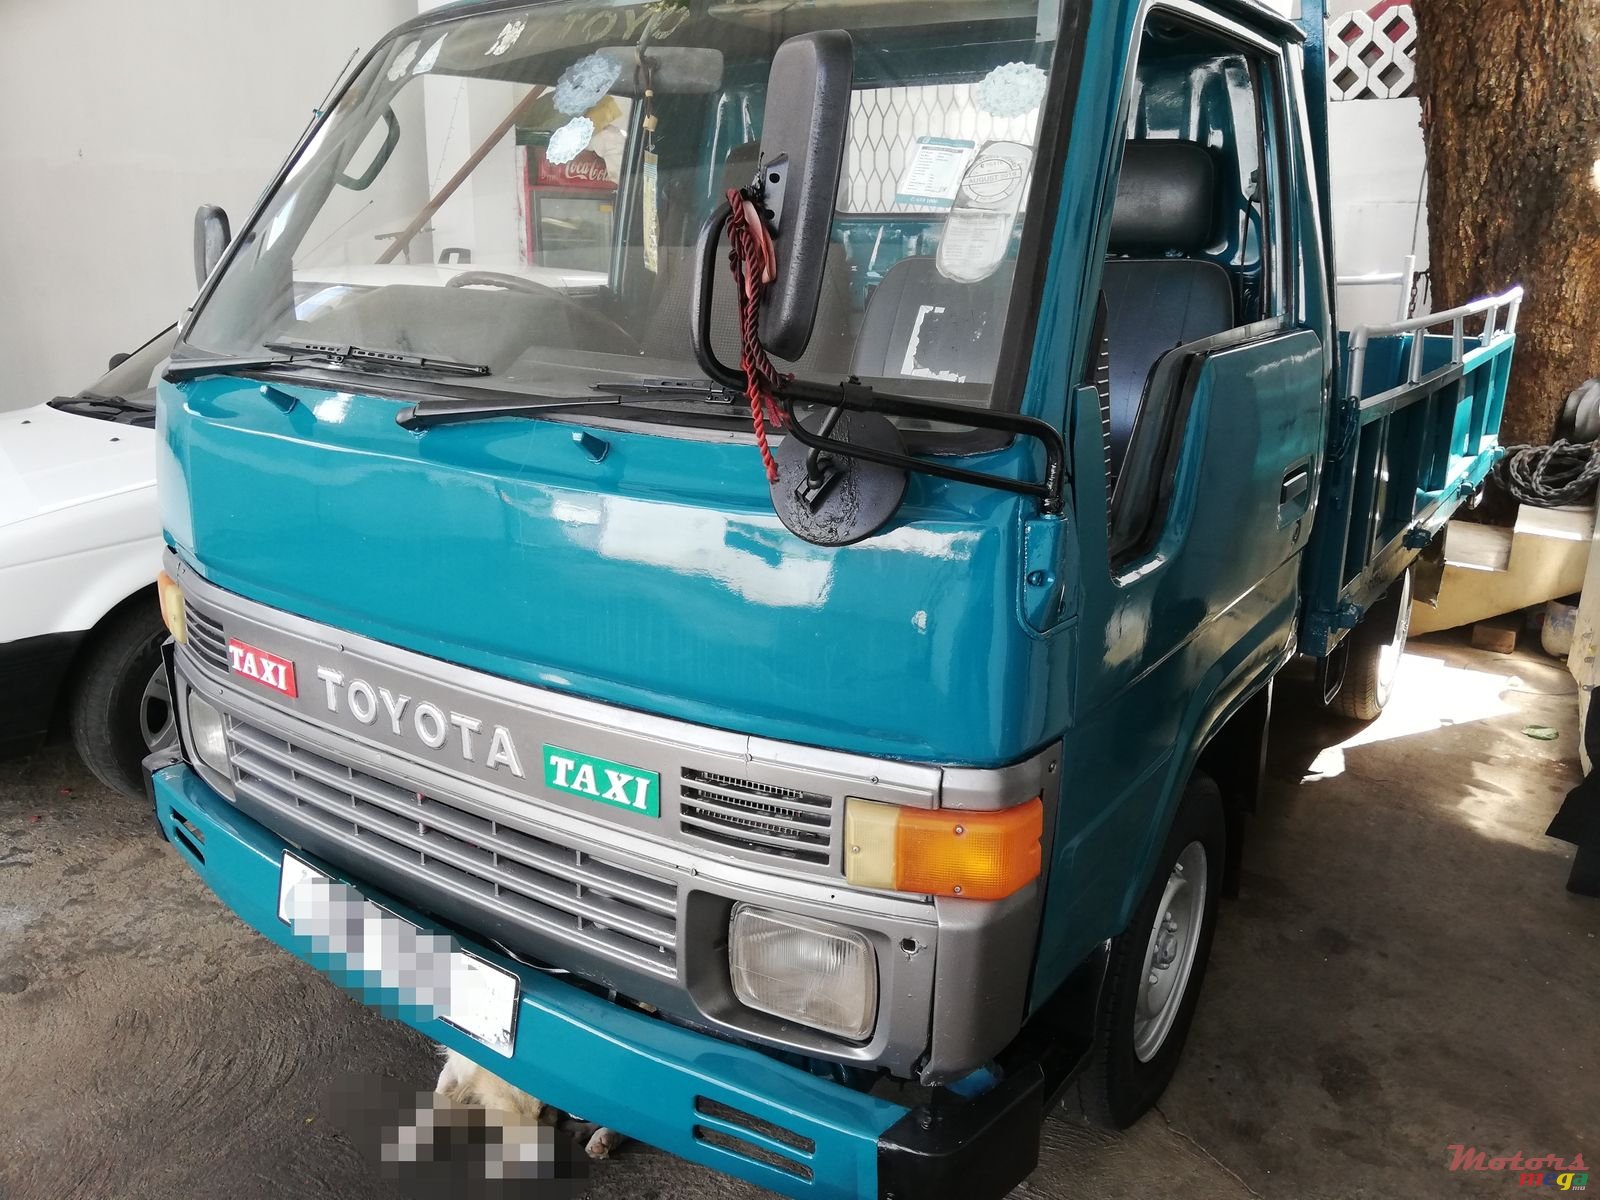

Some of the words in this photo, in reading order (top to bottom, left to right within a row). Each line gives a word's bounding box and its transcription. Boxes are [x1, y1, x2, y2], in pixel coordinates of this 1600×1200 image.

[228, 645, 288, 691] TAXI
[317, 666, 527, 779] TOYOTA
[549, 755, 650, 811] TAXI
